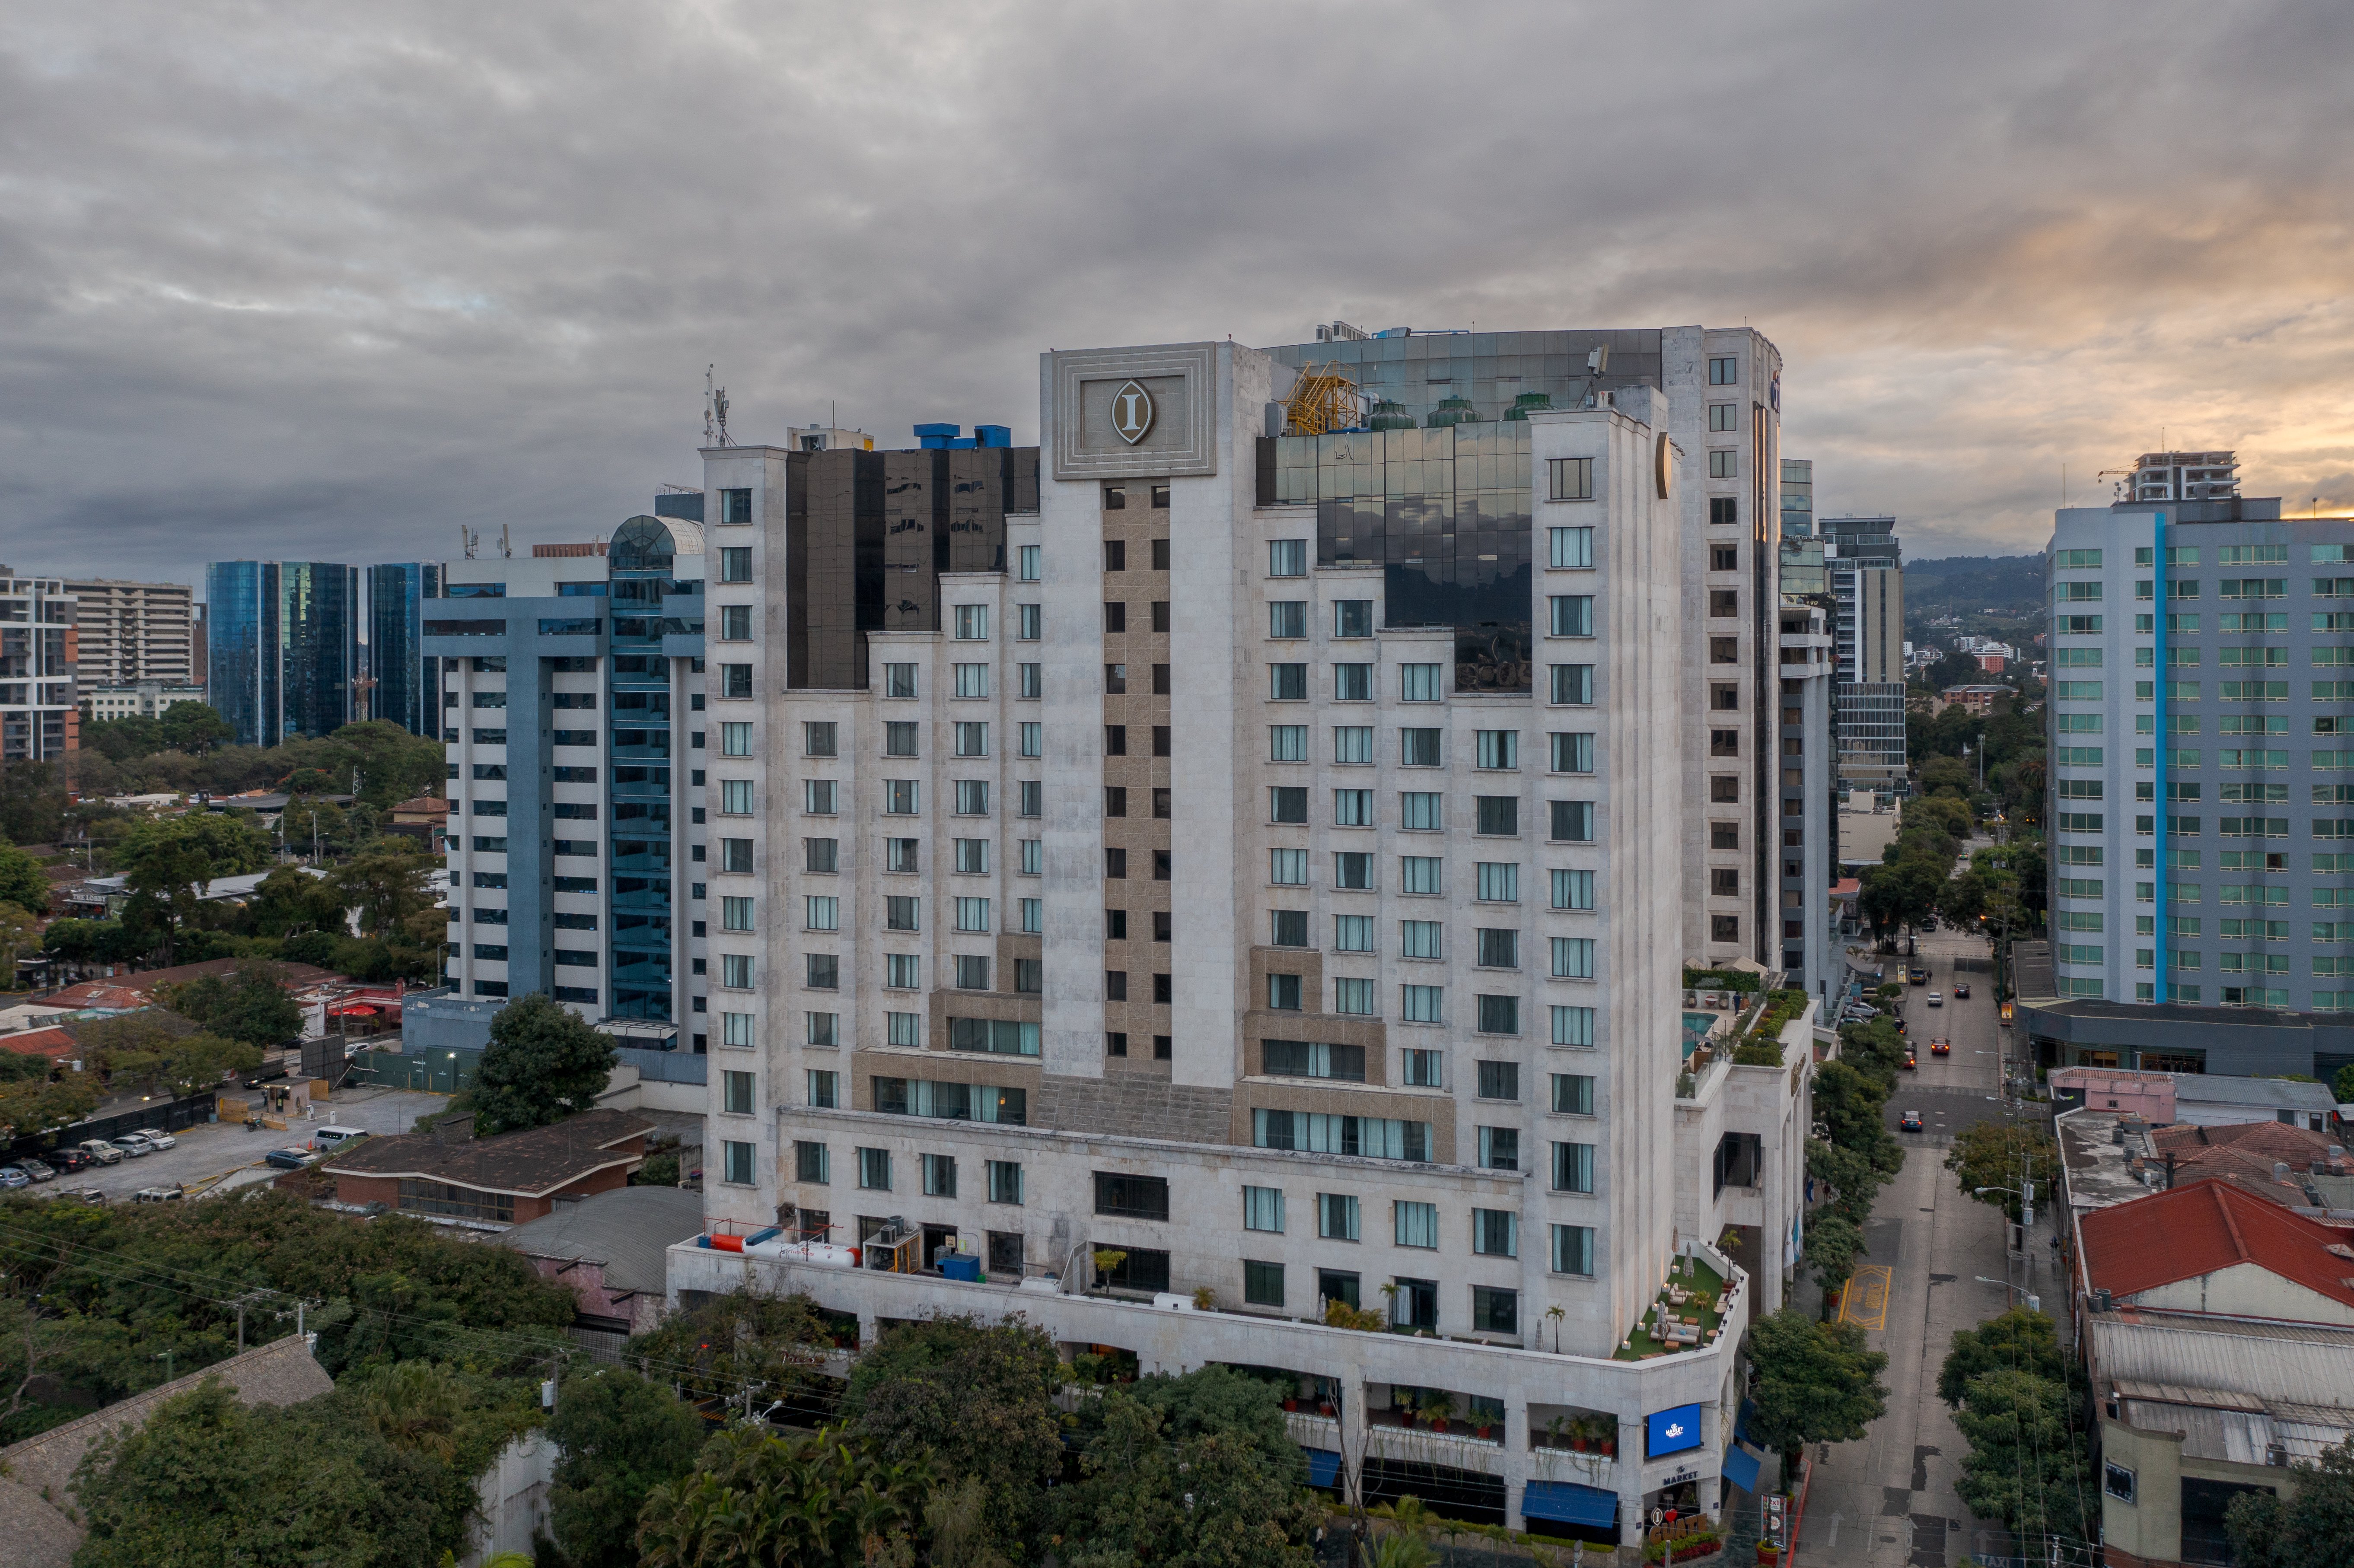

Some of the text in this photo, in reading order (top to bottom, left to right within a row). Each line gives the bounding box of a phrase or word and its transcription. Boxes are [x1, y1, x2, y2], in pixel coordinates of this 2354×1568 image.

[1122, 394, 1140, 431] I
[1666, 1426, 1683, 1434] MARKET
[1663, 1470, 1698, 1485] MARKET
[1979, 1554, 2010, 1568] TAXI
